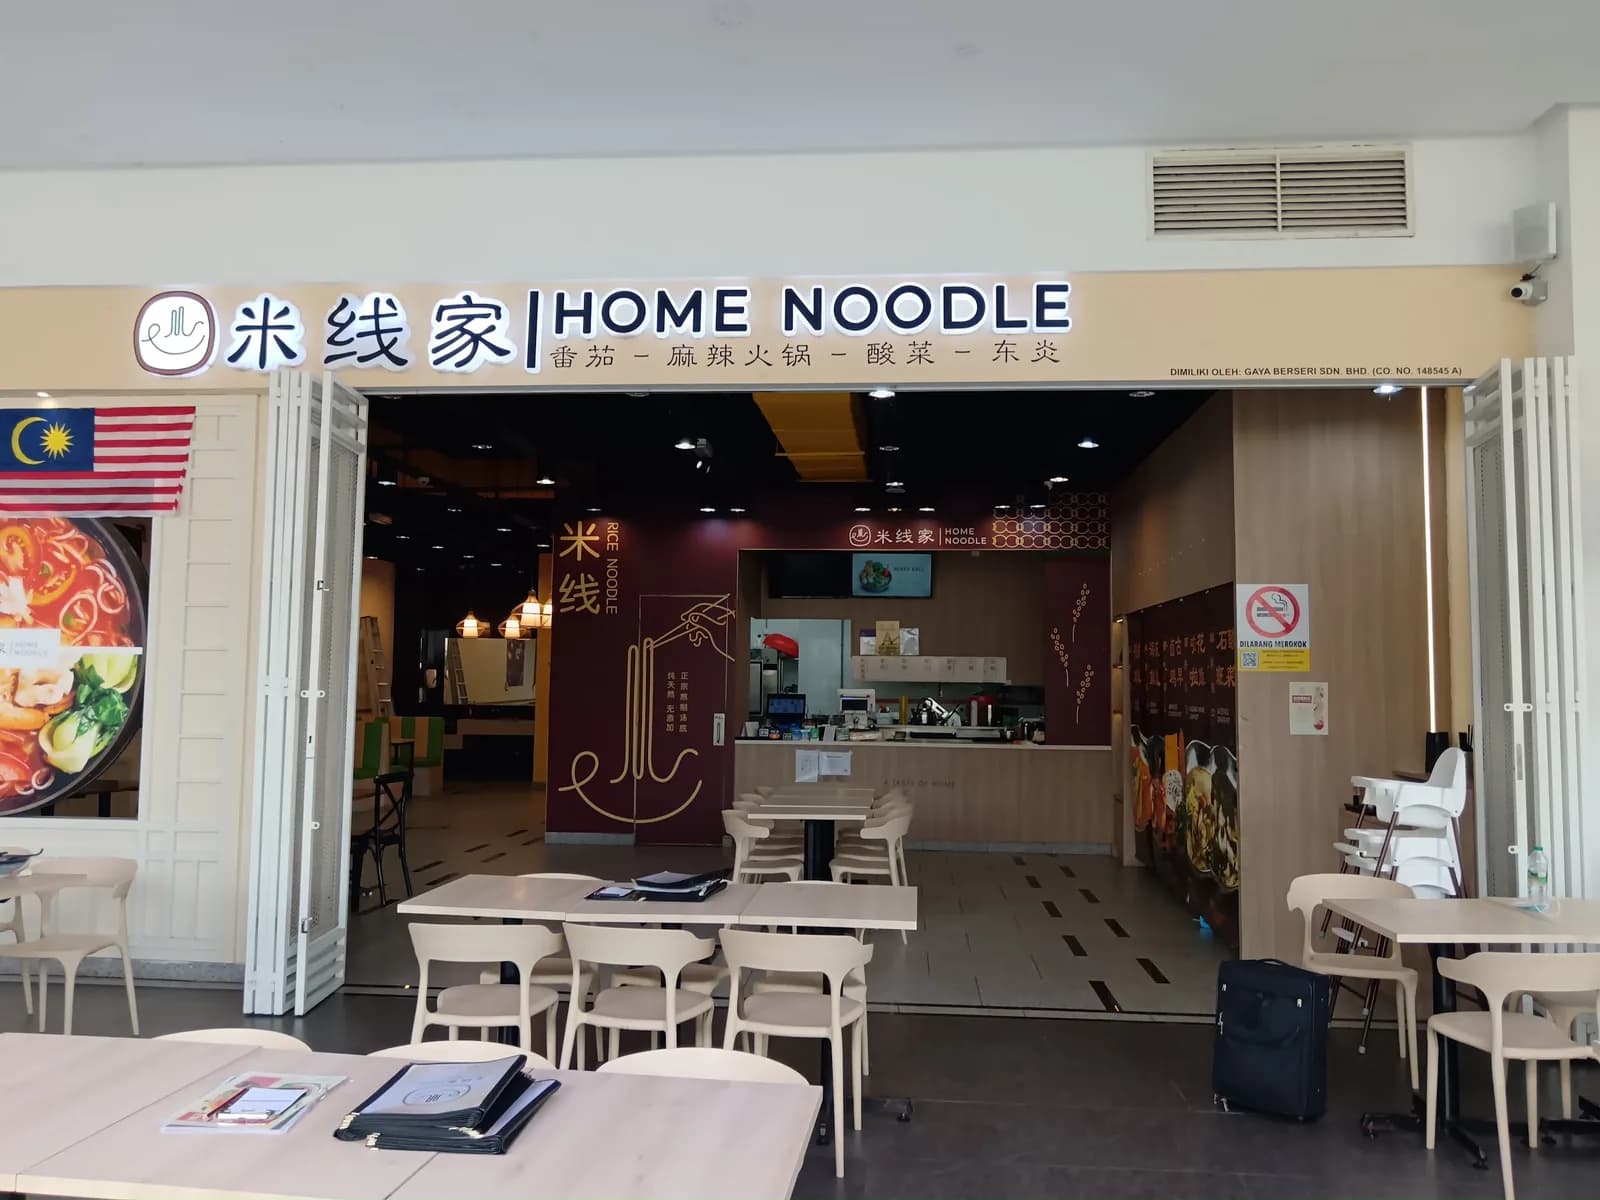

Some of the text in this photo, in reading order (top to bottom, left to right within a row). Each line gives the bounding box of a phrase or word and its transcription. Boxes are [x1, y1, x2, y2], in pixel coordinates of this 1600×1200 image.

[554, 284, 1070, 335] HOME NOODLE
[227, 295, 511, 370] 米线家
[549, 344, 616, 369] 番茄
[666, 342, 812, 368] 麻辣火锅
[866, 340, 936, 366] 酸菜
[991, 338, 1060, 364] 东炎
[1170, 366, 1462, 377] DIMILIKI OLEH: GAYA BERSERI SDN. BHD. (CO. NO. 148545 A)
[874, 528, 935, 545] 米线家
[944, 527, 975, 536] HOME
[944, 536, 987, 546] NOODLE
[559, 520, 600, 615] 米线
[605, 522, 619, 615] RICE NOODLE
[1240, 640, 1307, 648] DILARANG MEROKOK
